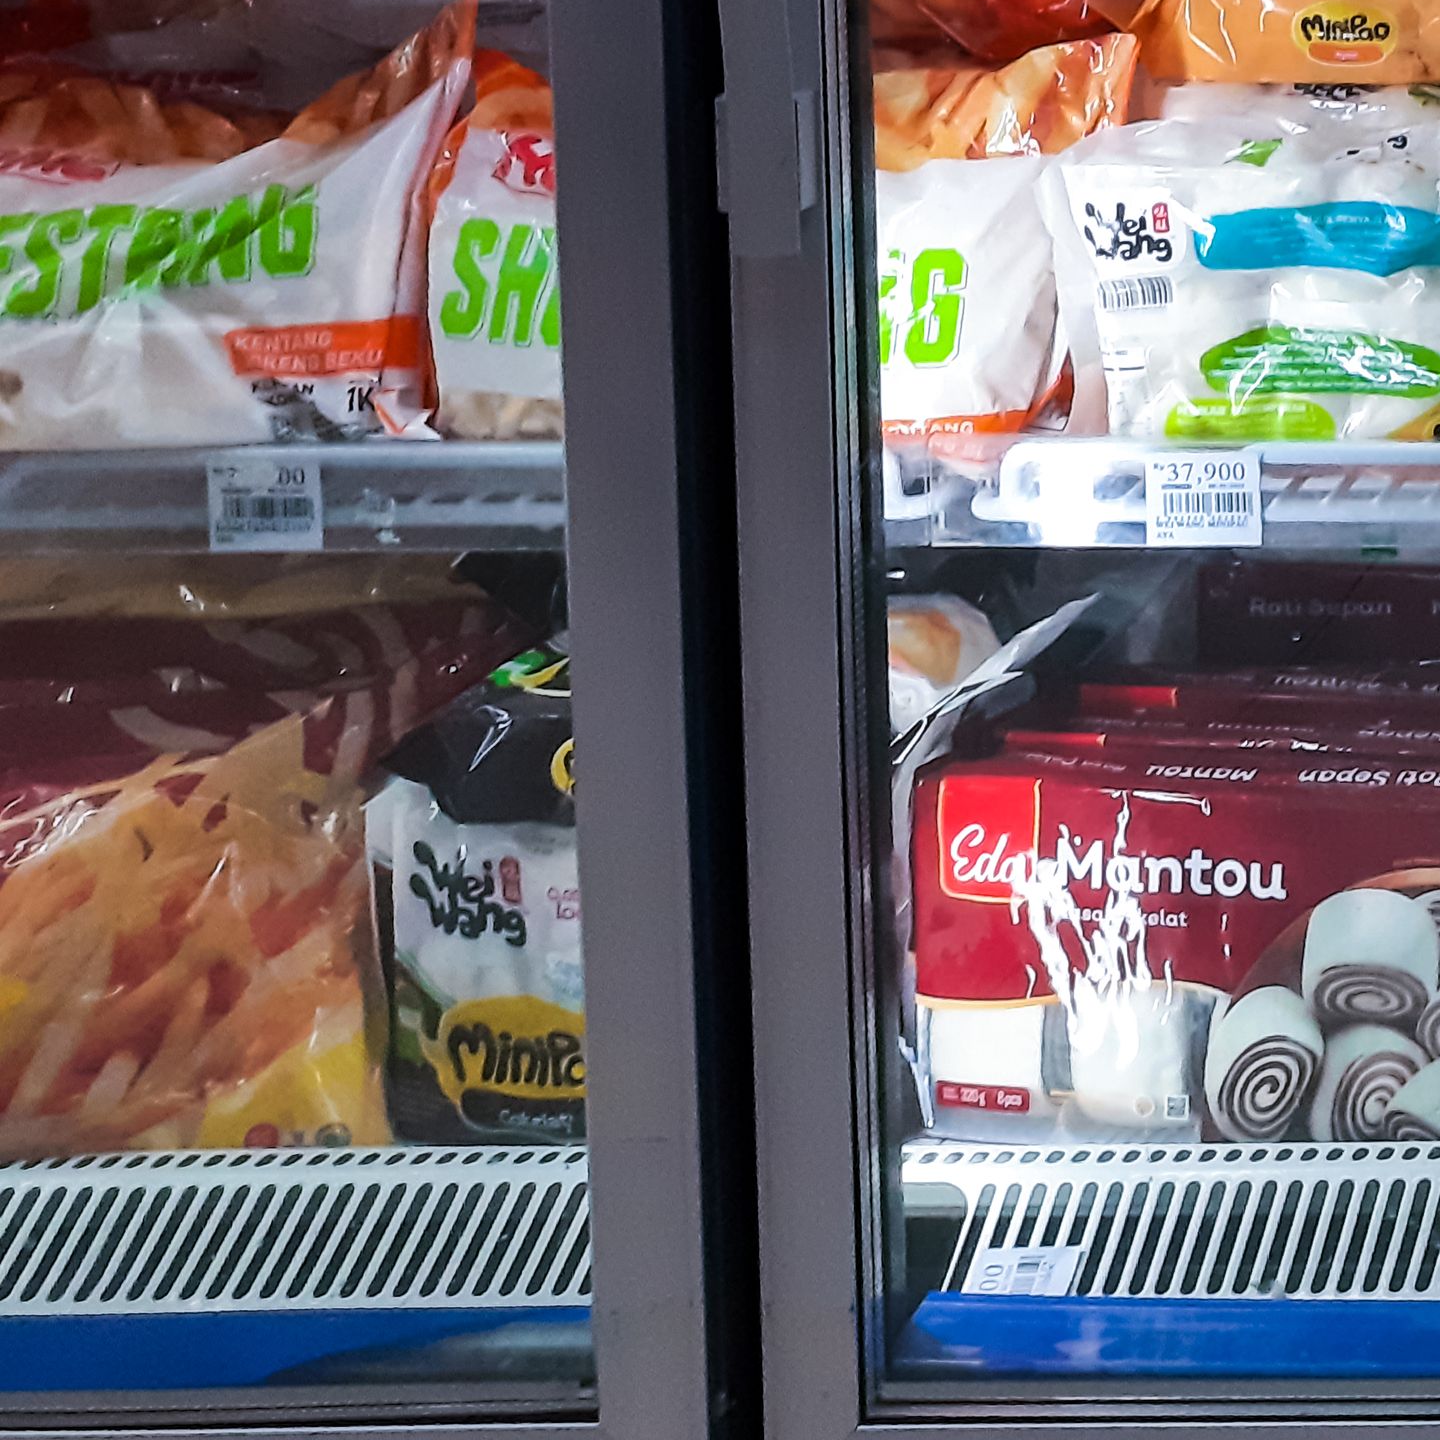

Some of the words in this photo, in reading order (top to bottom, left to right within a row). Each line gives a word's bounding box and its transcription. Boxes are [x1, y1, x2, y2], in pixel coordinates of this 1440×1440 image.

[323, 348, 384, 370] BEKU
[1166, 462, 1247, 486] 37,900
[411, 839, 495, 903] Wei
[1055, 838, 1288, 901] Mantou
[408, 874, 527, 946] Wang
